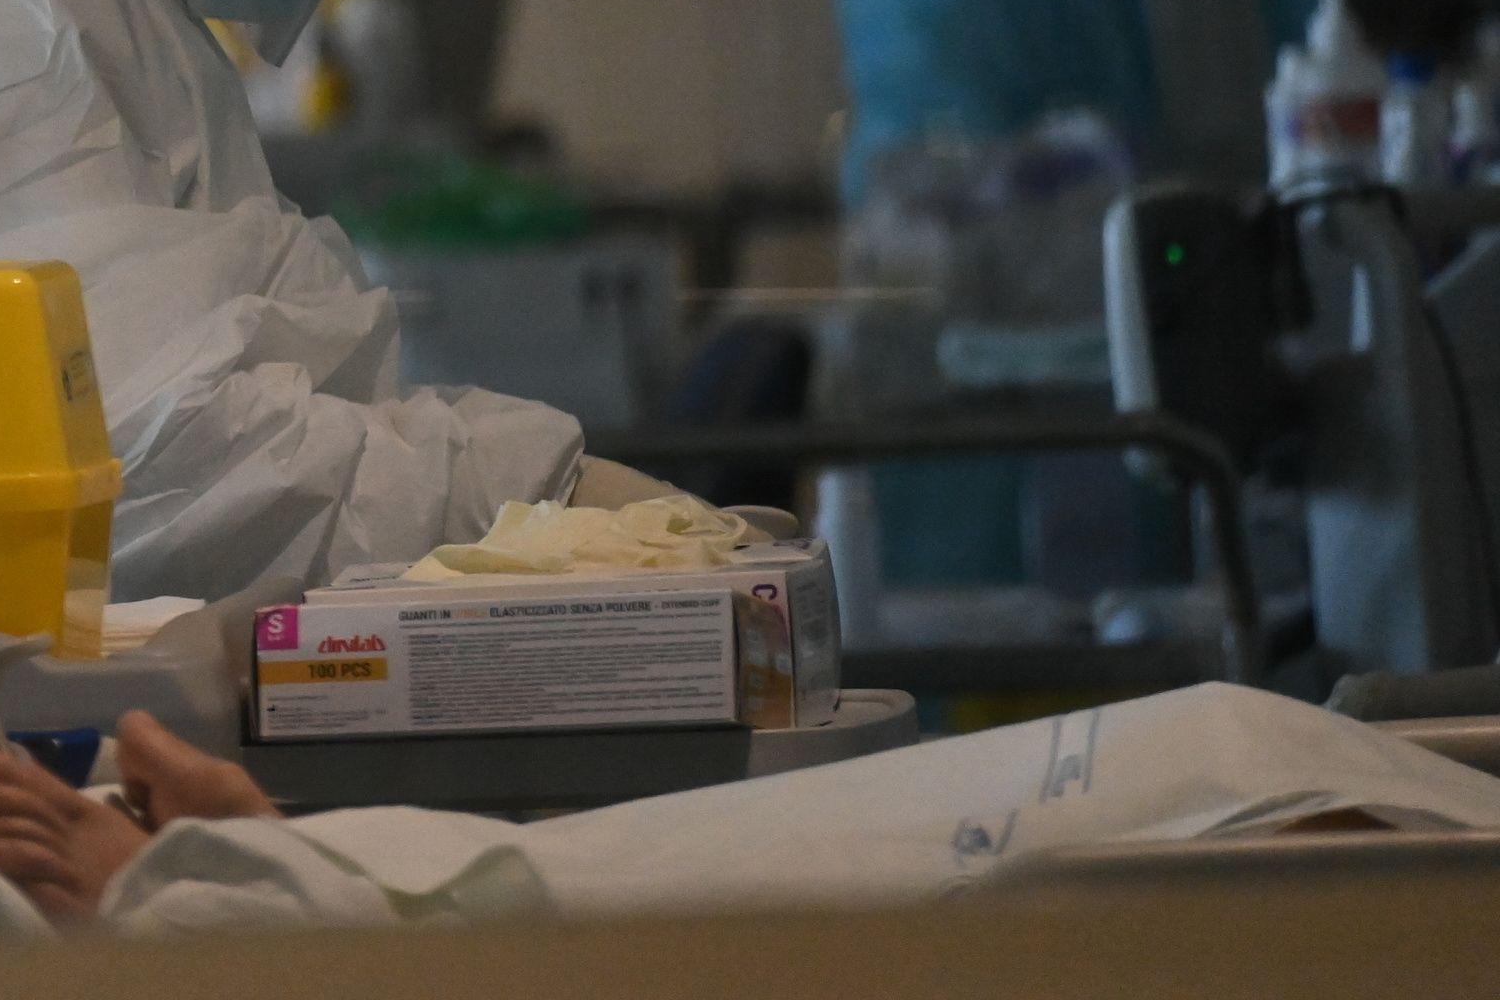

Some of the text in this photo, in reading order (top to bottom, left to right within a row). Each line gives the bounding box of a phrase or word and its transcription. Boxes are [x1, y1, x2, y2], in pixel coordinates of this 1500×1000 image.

[570, 602, 603, 614] SENZA
[605, 600, 652, 613] POLVERE
[267, 613, 285, 635] S
[308, 662, 373, 679] 100 PCS
